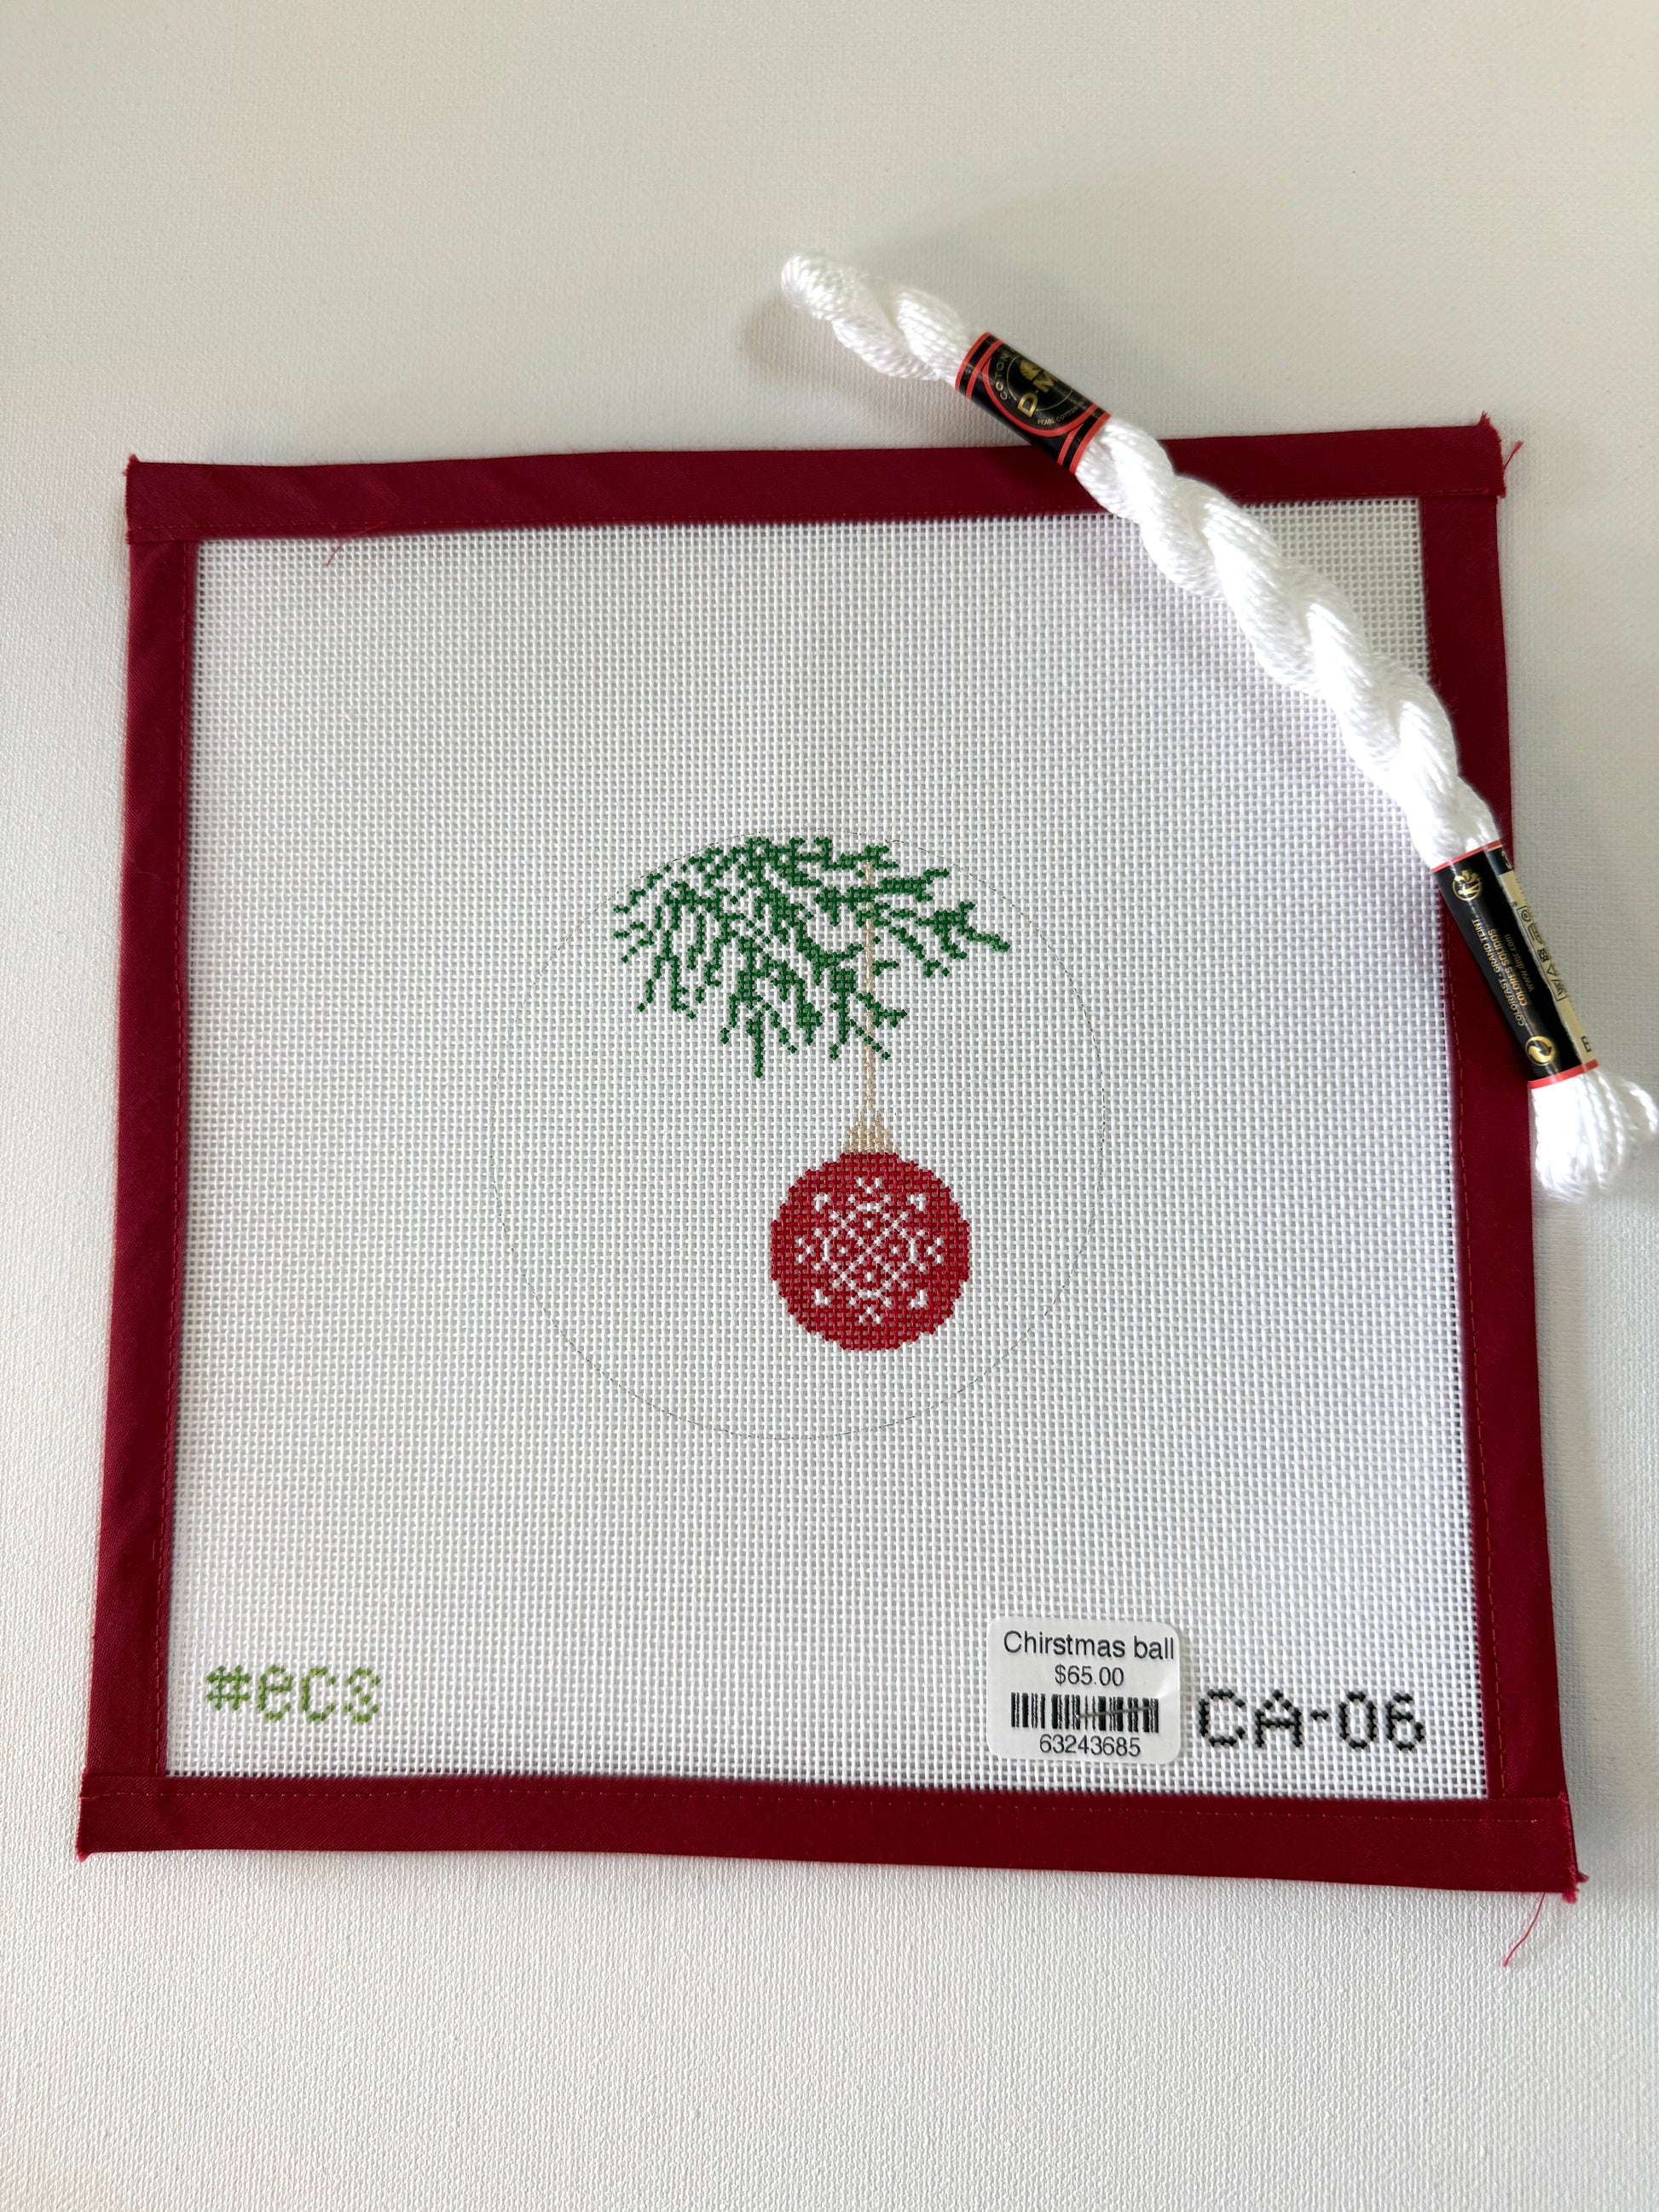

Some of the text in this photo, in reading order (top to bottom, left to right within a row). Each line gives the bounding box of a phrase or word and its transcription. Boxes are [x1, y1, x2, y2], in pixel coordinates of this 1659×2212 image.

[1471, 919, 1488, 944] TEINT
[1483, 943, 1500, 973] GRAND
[1487, 928, 1528, 1007] COLORES SOLIDOS
[1498, 978, 1524, 1026] COLORFAST
[1003, 1630, 1174, 1660] Chirstmas ball
[1055, 1663, 1124, 1687] $65.00
[1198, 1689, 1425, 1751] CA-06
[1039, 1733, 1141, 1757] 63243685
